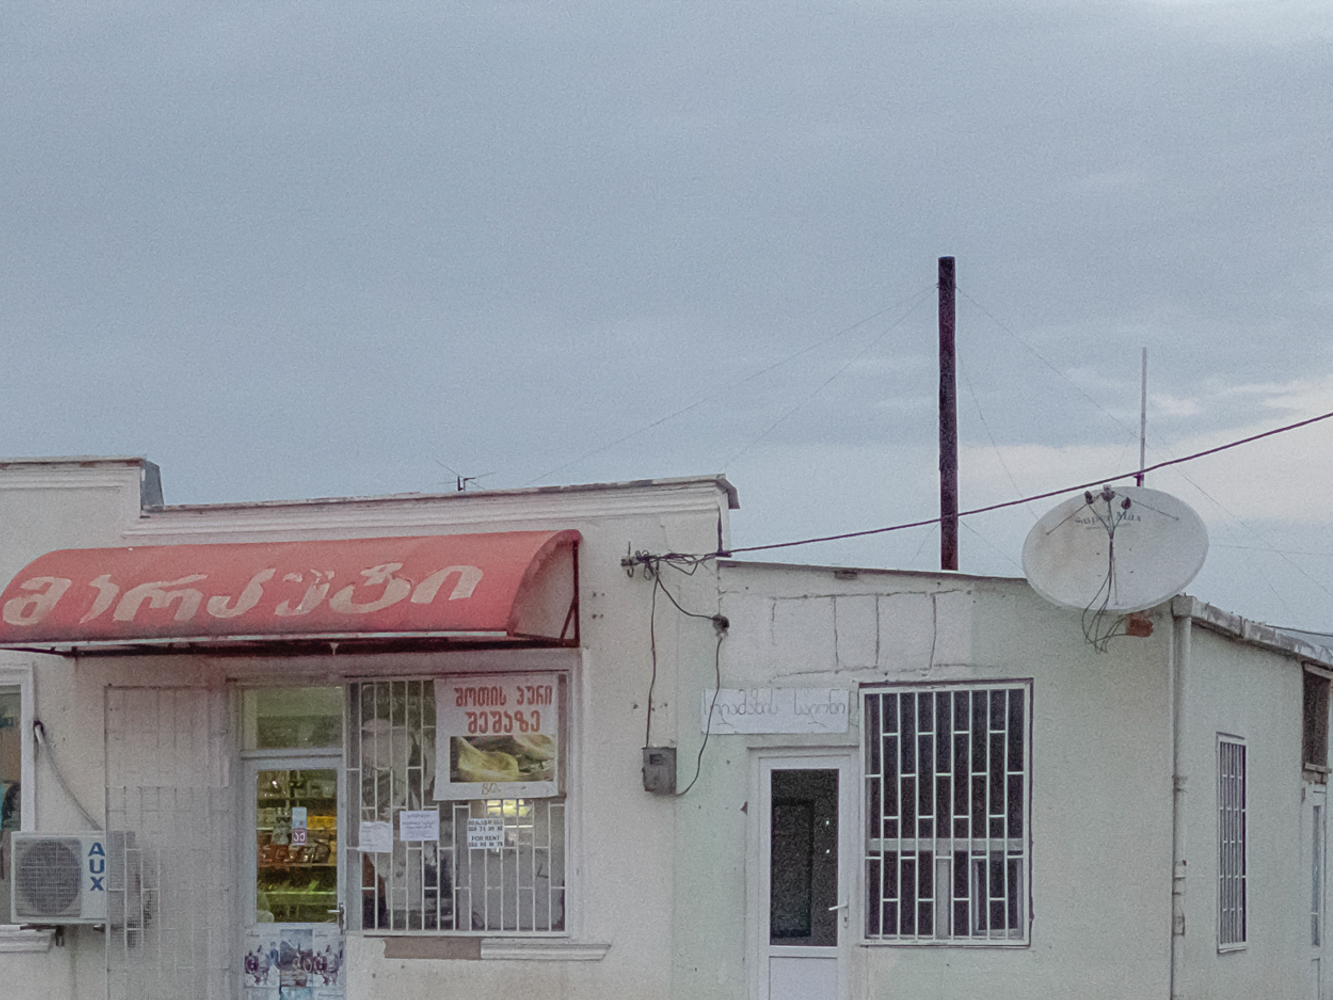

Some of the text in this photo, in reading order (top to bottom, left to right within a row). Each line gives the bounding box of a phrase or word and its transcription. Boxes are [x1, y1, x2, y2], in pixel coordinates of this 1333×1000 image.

[2, 562, 485, 626] მარკეტი
[454, 685, 553, 707] შოთის პური
[793, 688, 846, 728] სალონი
[465, 710, 541, 734] შეშაზე
[88, 842, 105, 891] AUX
